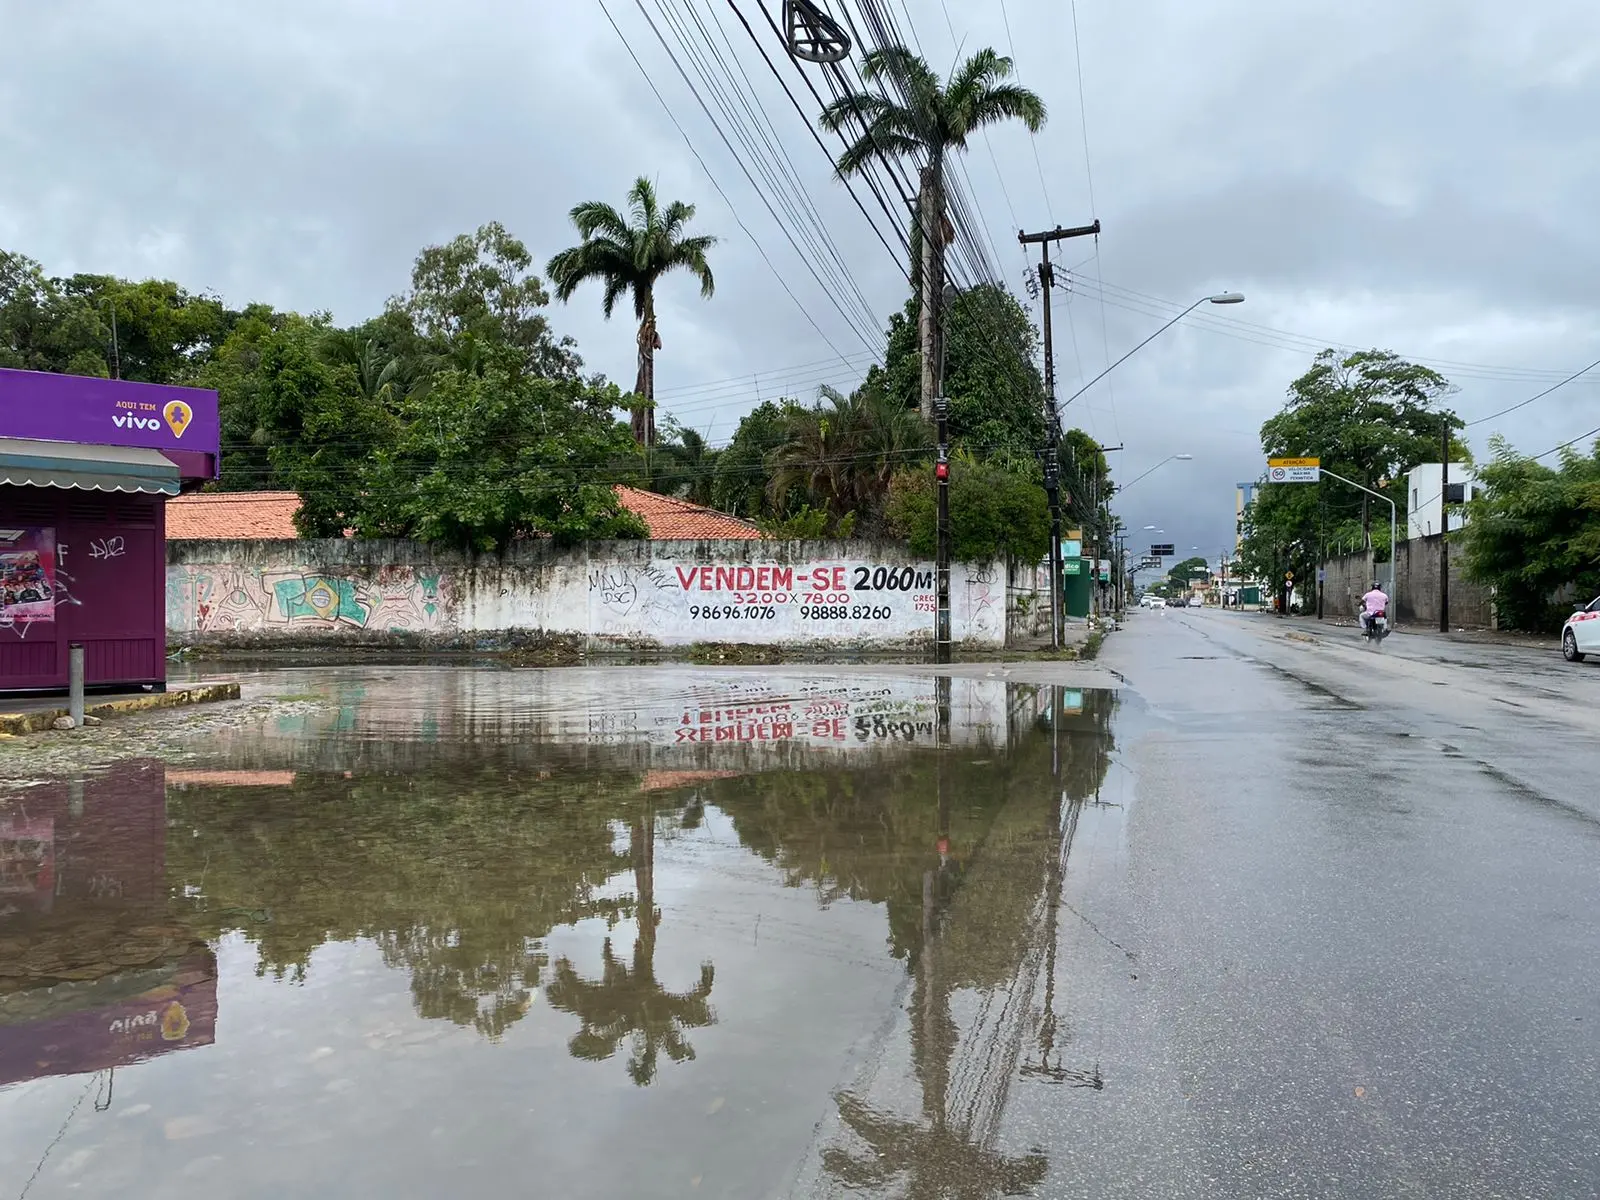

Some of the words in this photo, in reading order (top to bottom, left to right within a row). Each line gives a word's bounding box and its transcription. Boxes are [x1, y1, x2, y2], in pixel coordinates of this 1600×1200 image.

[116, 401, 137, 409] AQUI
[139, 403, 156, 411] TEM
[112, 411, 160, 431] vivo
[853, 566, 937, 591] 2.060M
[801, 593, 850, 604] 78.00
[689, 605, 776, 620] 98696.1076
[800, 605, 892, 620] 98888.8260
